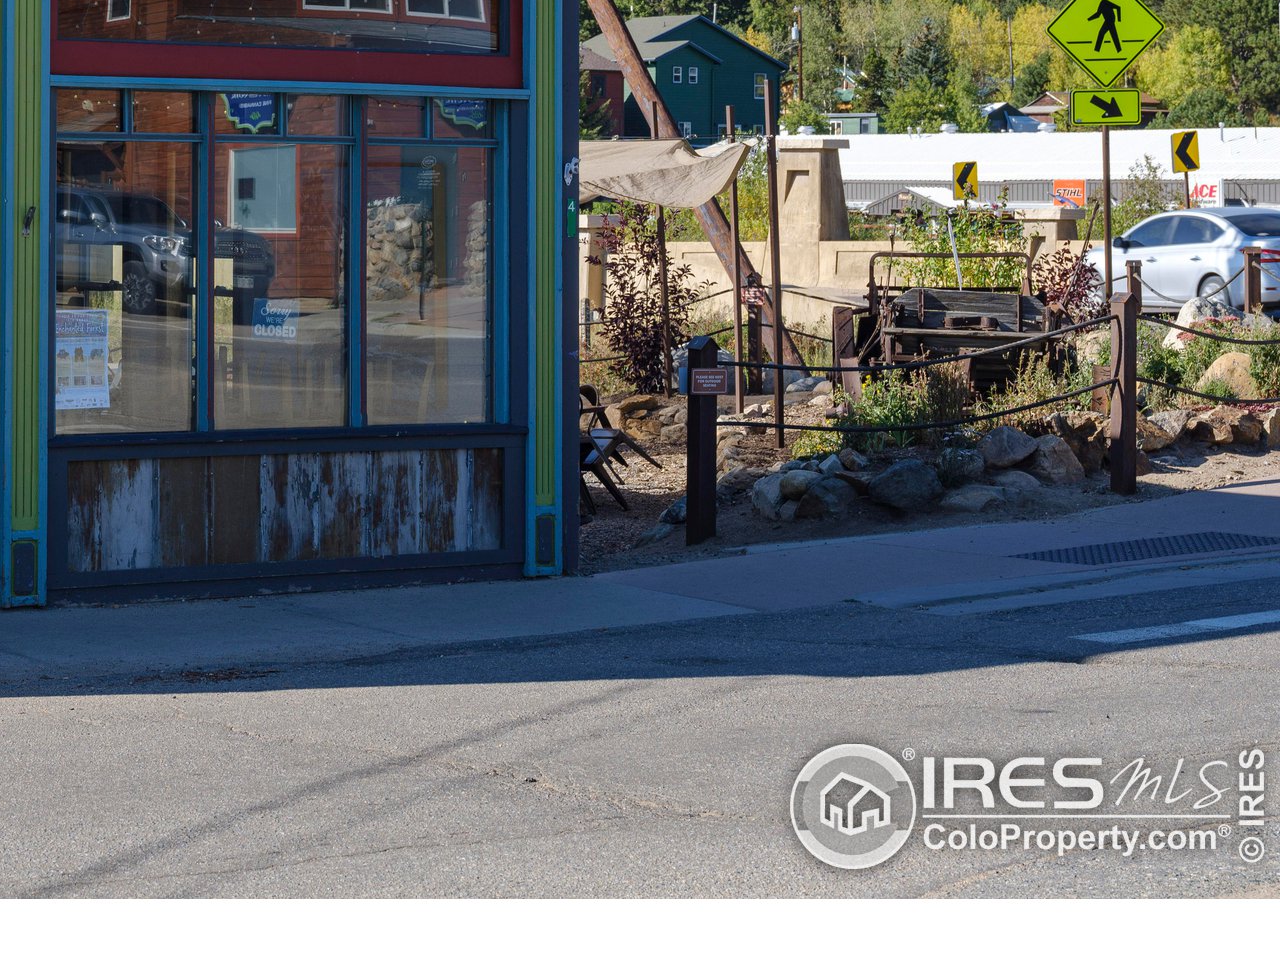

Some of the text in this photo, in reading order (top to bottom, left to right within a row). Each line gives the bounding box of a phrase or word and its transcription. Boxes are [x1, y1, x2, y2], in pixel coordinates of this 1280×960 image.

[1056, 188, 1083, 197] STIHL
[1190, 184, 1217, 198] ACE
[568, 201, 575, 212] 4
[261, 303, 291, 321] Sorry
[254, 324, 296, 338] CLOSED
